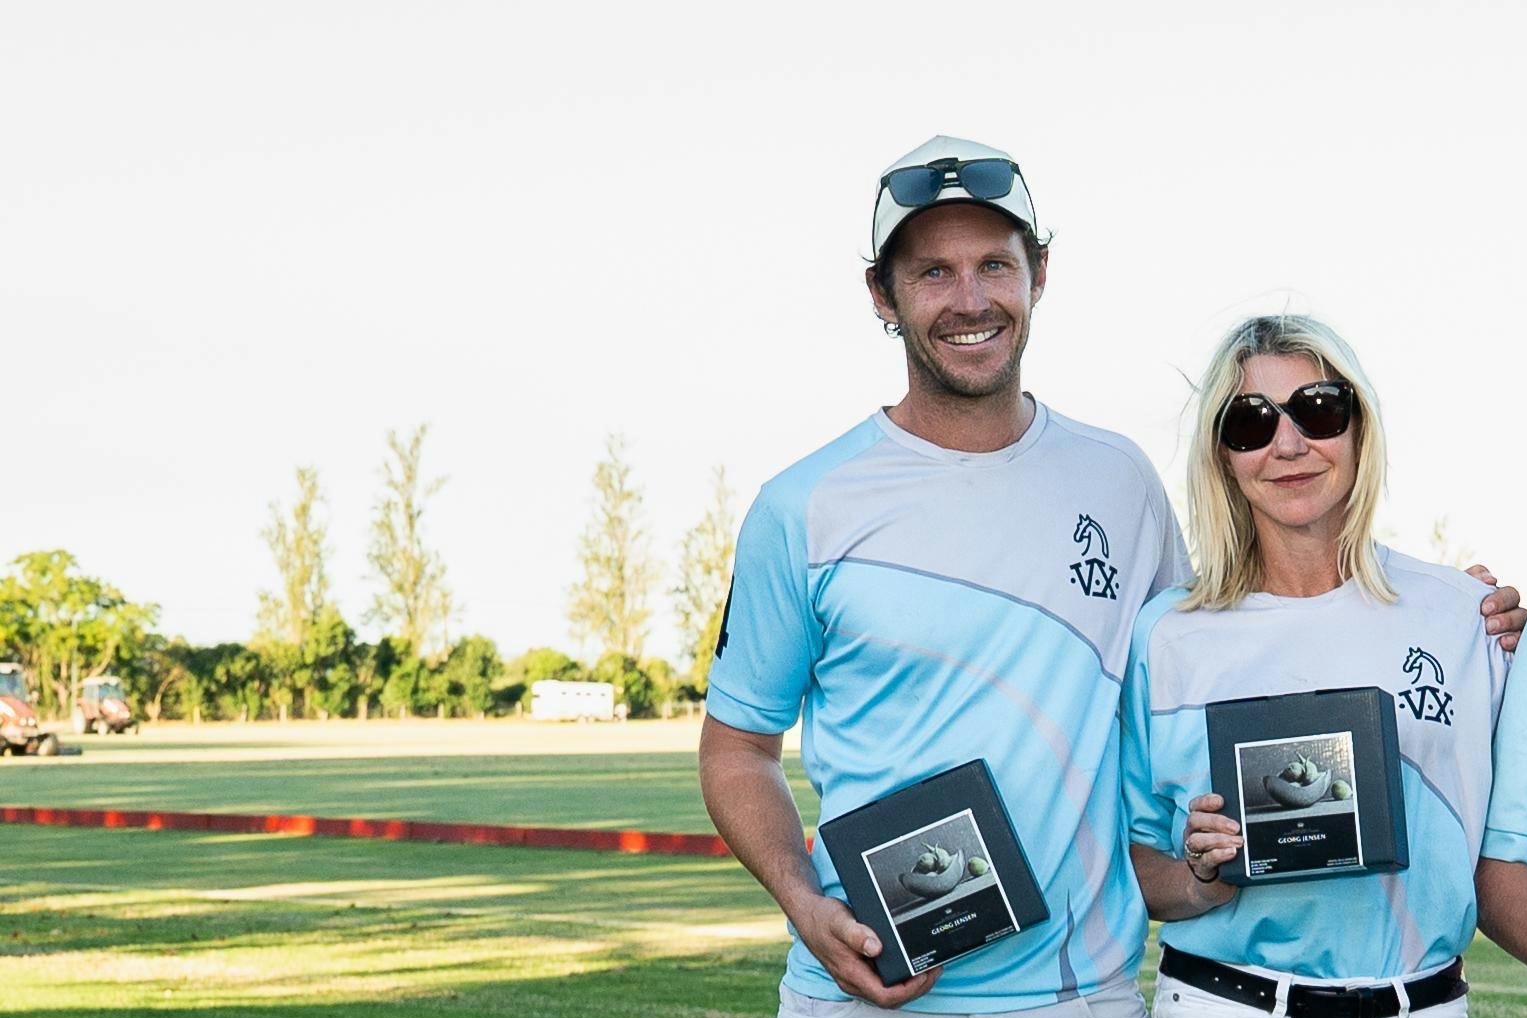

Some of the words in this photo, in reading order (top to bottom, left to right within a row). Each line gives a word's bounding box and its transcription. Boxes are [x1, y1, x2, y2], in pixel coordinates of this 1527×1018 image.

[1278, 836, 1302, 844] GEORG
[1303, 833, 1326, 842] JENSEN
[931, 920, 954, 935] GEORG
[955, 912, 977, 928] JENSEN
